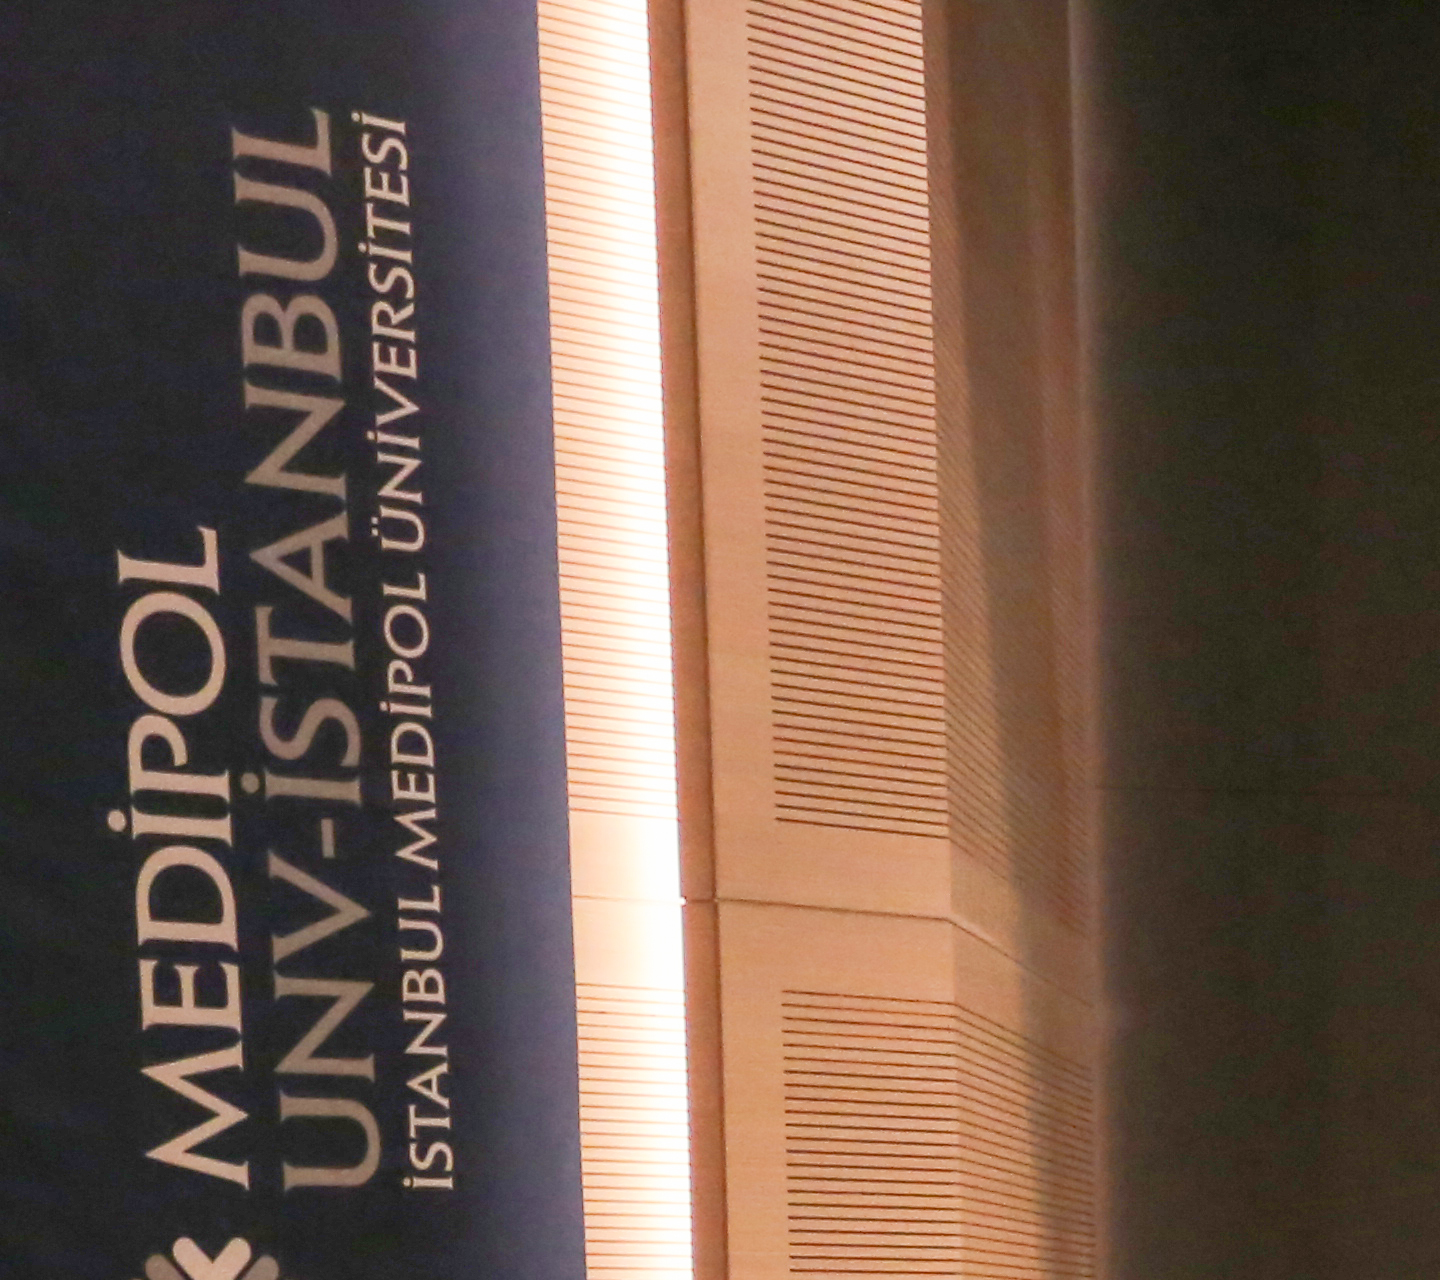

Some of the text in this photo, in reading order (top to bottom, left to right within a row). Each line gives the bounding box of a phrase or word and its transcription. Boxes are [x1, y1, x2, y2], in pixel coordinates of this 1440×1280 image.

[108, 524, 250, 1192] MEDİPOL
[231, 108, 383, 1195] UNV-İSTANBUL
[350, 109, 454, 1192] İSTANBUL MEDİPOL ÜNİVERSİTESİ
